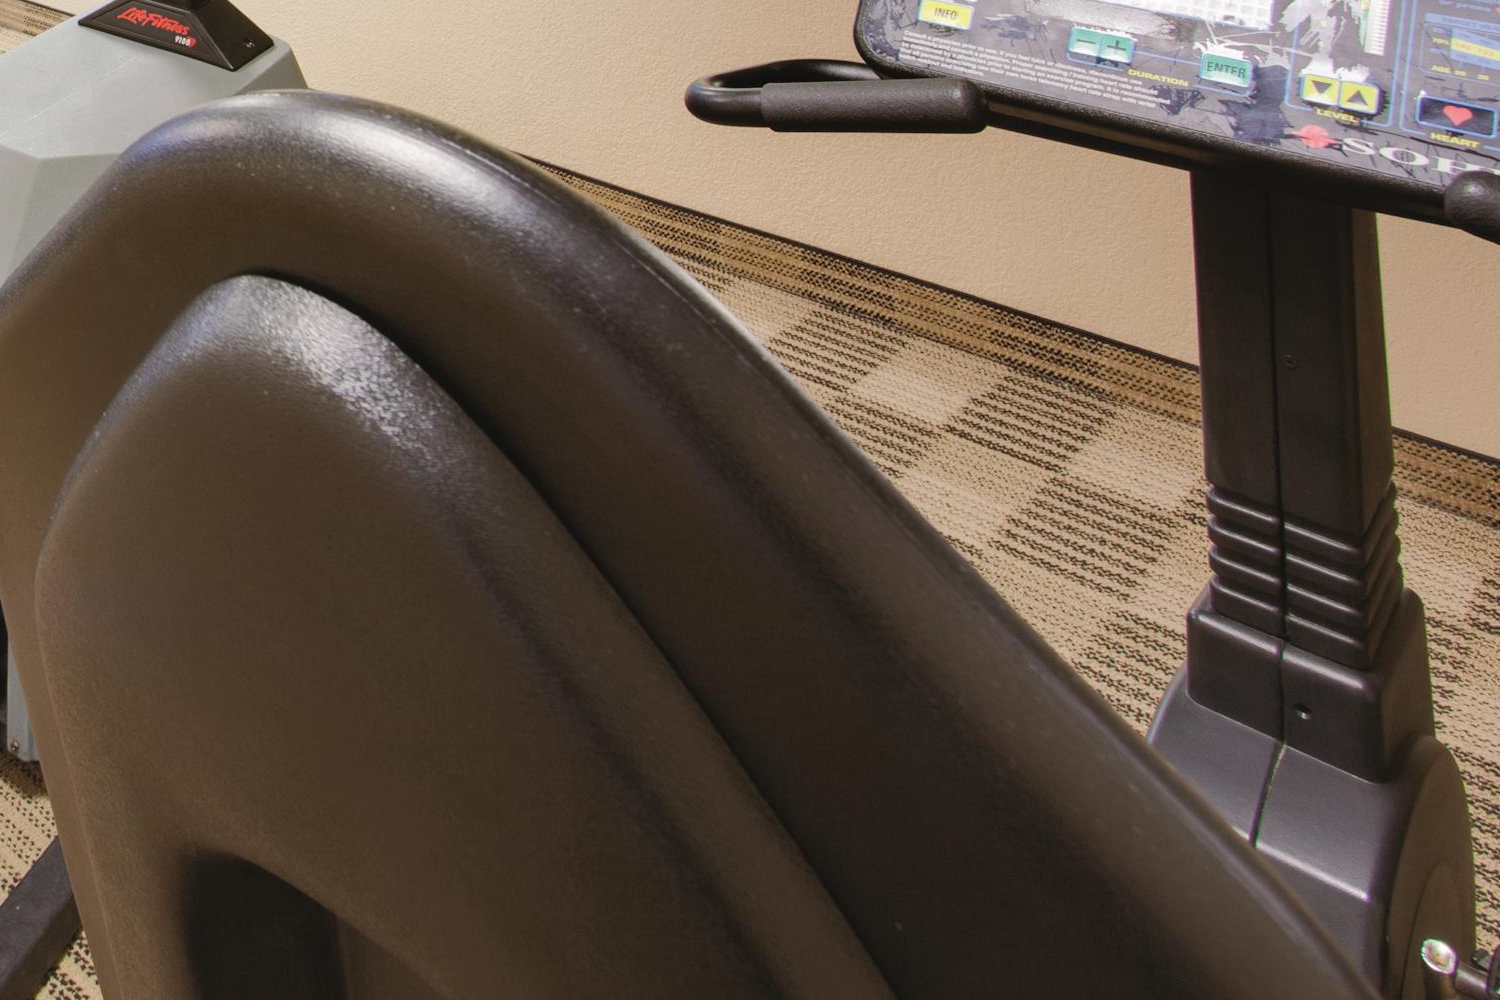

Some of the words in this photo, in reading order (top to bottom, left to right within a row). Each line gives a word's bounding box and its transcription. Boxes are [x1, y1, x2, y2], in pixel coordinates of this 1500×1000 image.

[934, 6, 959, 21] INFO
[174, 35, 192, 47] 9100
[1127, 68, 1189, 87] DURATION
[1206, 60, 1247, 79] ENTER
[1316, 107, 1358, 123] LEVEL
[1430, 131, 1481, 148] HEART
